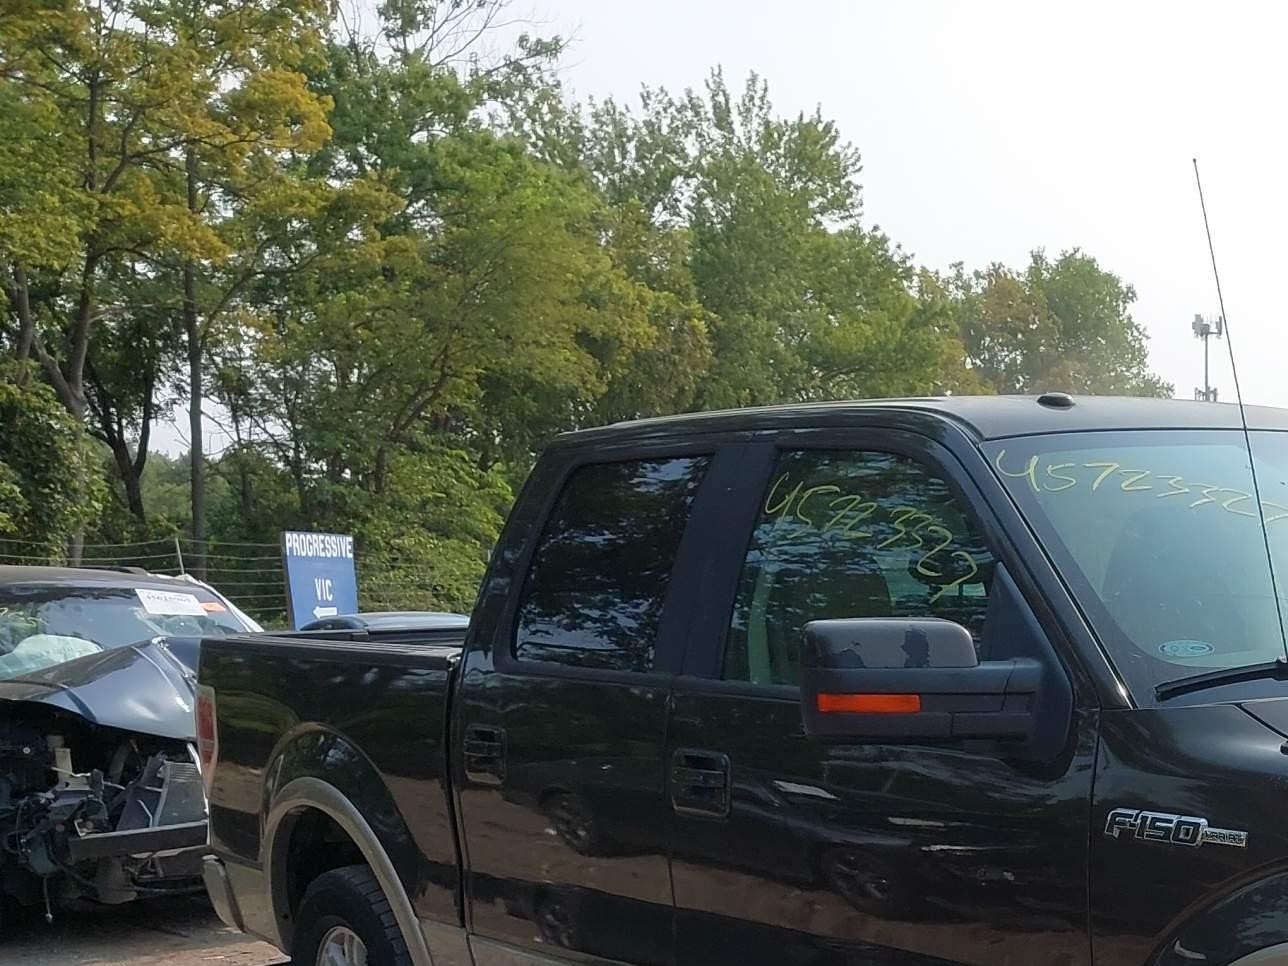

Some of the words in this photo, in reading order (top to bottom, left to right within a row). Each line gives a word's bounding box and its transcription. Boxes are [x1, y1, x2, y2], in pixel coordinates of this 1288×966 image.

[286, 533, 354, 559] PROGRESSIVE
[315, 578, 333, 601] VIC
[1104, 808, 1208, 848] F-150
